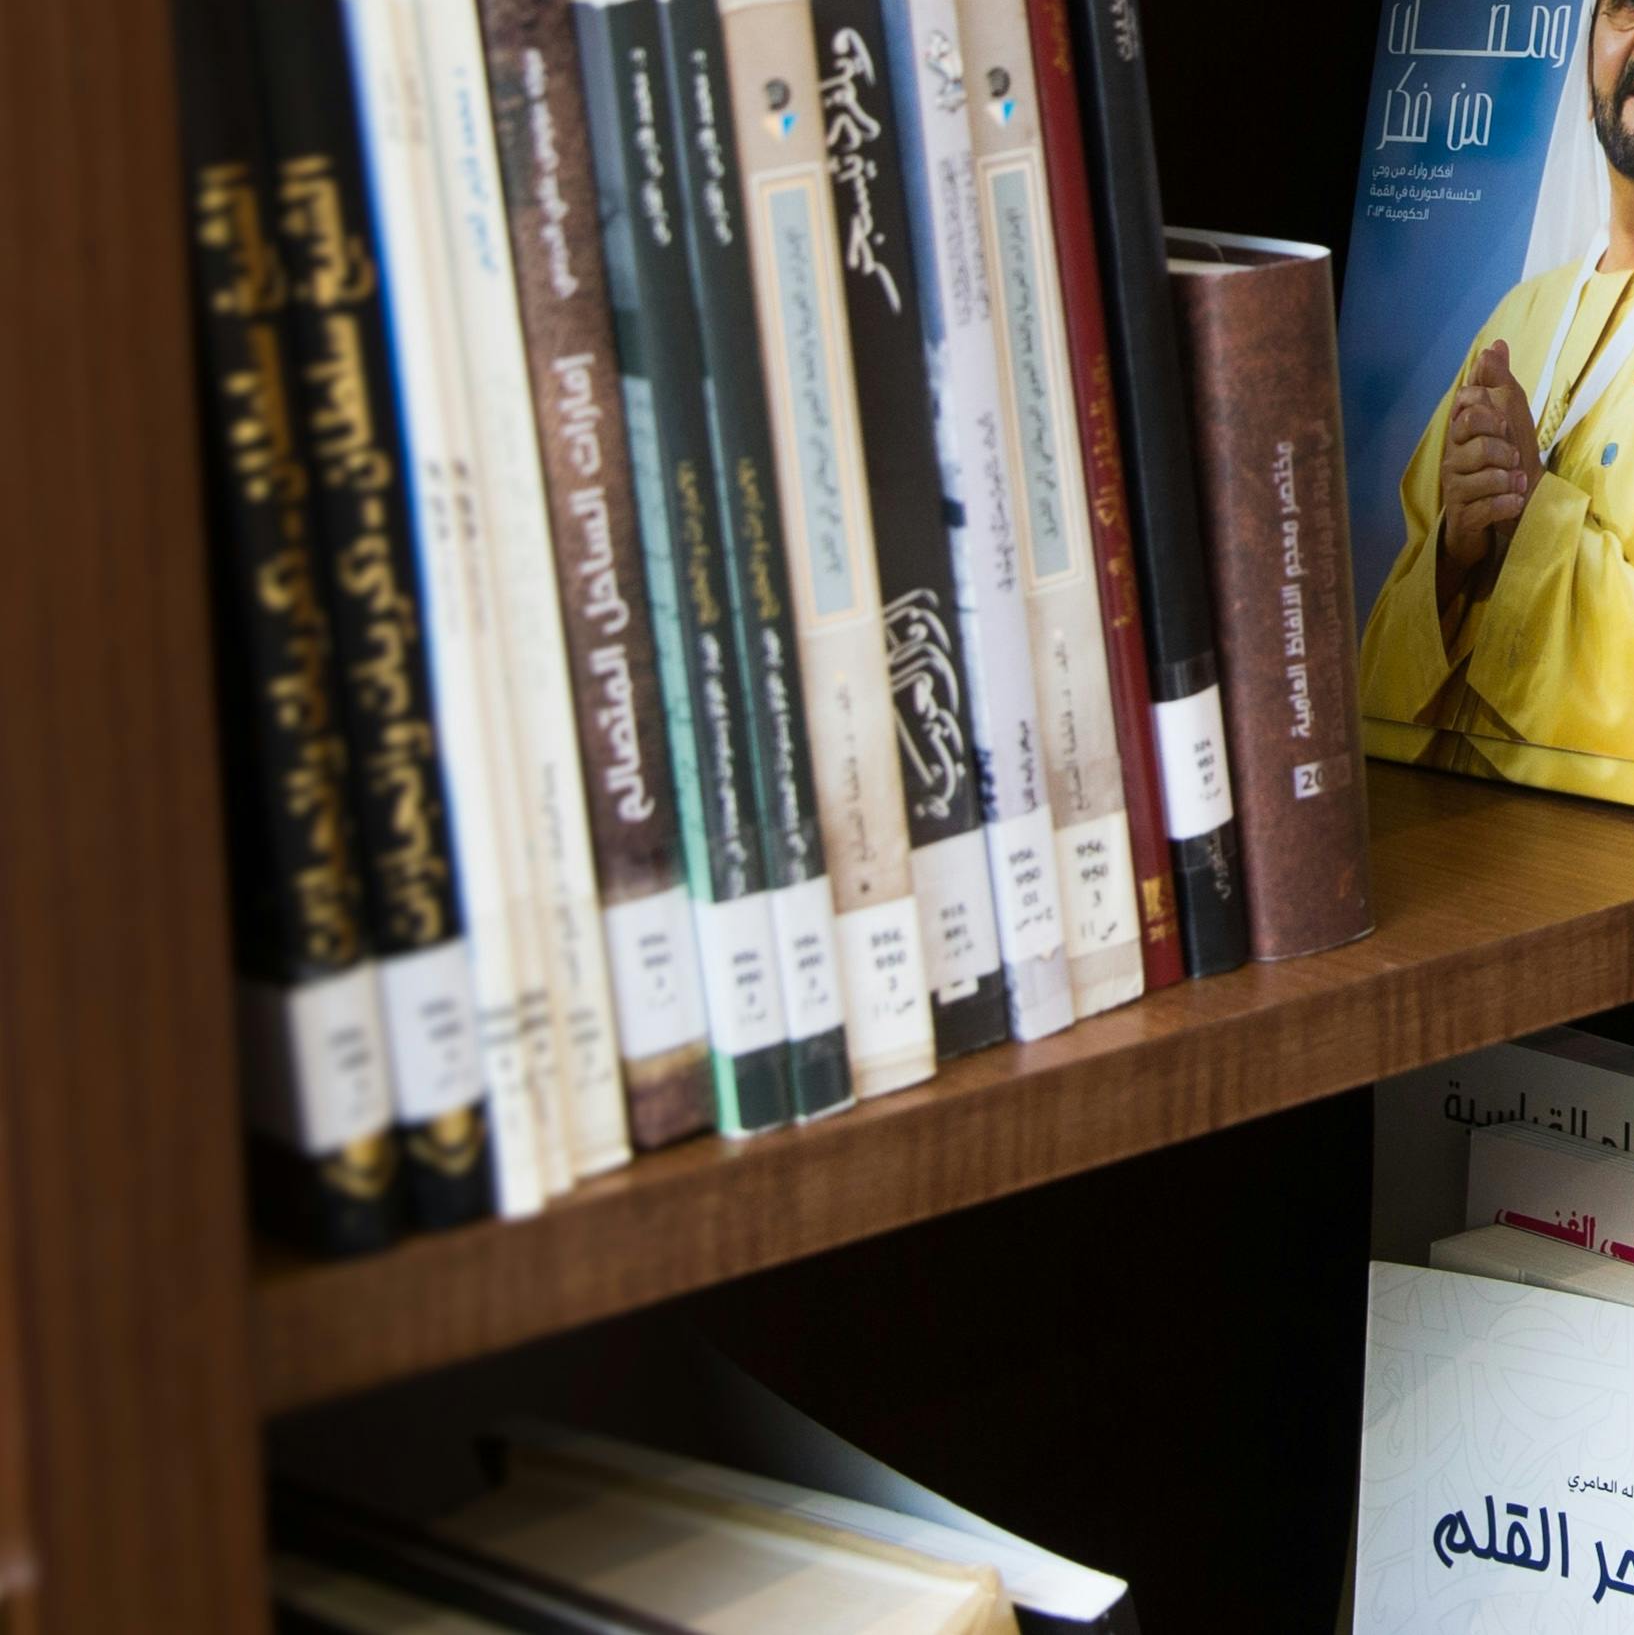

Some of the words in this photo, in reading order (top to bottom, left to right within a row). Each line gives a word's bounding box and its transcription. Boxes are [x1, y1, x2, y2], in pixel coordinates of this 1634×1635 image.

[1376, 62, 1431, 149] فكر
[1447, 83, 1493, 150] من
[1568, 1475, 1617, 1493] العامري
[1433, 1495, 1569, 1578] القلم
